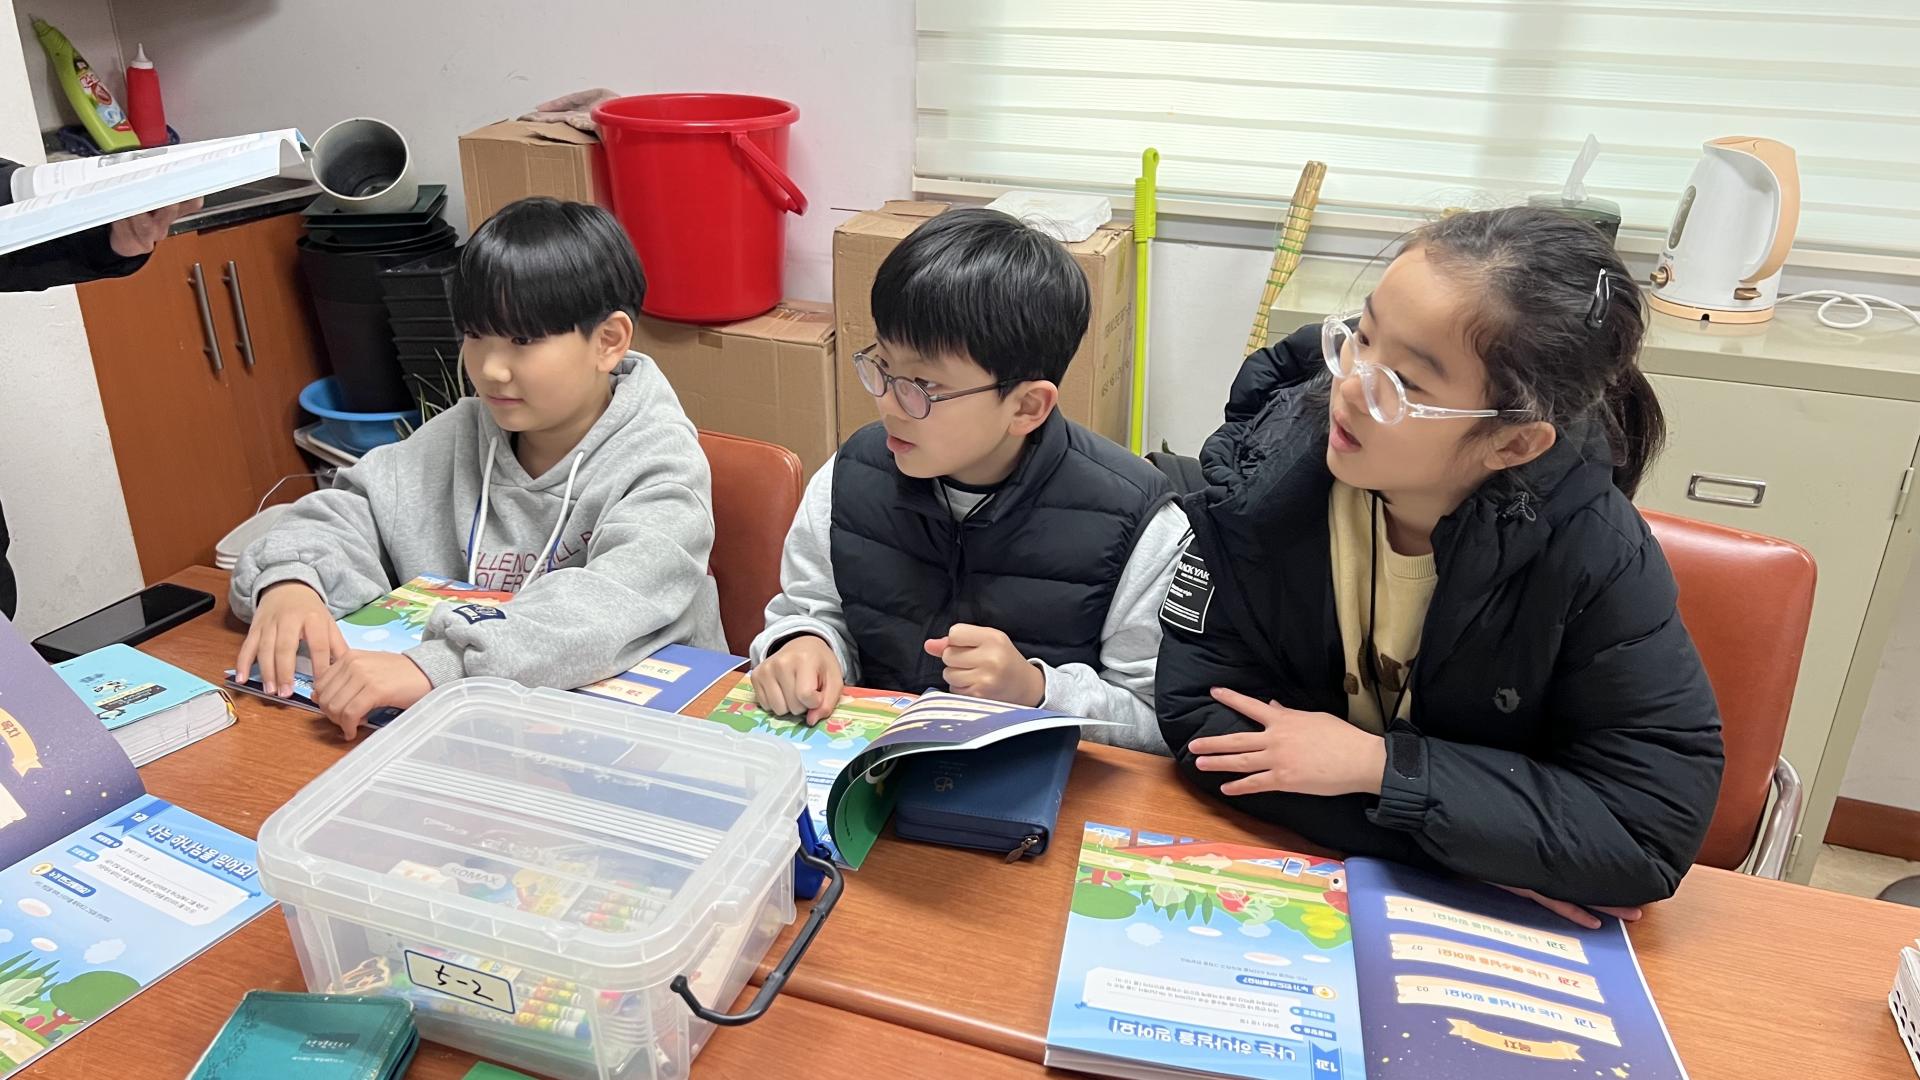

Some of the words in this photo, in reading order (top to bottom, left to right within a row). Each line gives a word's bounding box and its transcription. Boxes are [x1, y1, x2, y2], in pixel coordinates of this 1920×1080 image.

[147, 823, 172, 843] 나는
[170, 835, 219, 866] 하나님을
[212, 853, 258, 881] 믿어요!
[1546, 940, 1568, 951] 3과
[1438, 948, 1476, 962] 믿어요!
[1527, 969, 1549, 980] 나는
[1558, 975, 1581, 988] 2과
[434, 964, 495, 1002] 5-2
[1445, 988, 1484, 1003] 믿어요!
[1488, 996, 1536, 1013] 하나님을
[1538, 1008, 1563, 1020] 나는
[1110, 1018, 1173, 1042] 믿어요!
[1574, 1017, 1597, 1030] 1과
[1178, 1030, 1253, 1057] 하나님을
[1503, 1039, 1532, 1053] 목차
[1258, 1041, 1297, 1062] 나는
[1315, 1058, 1339, 1073] 1과
